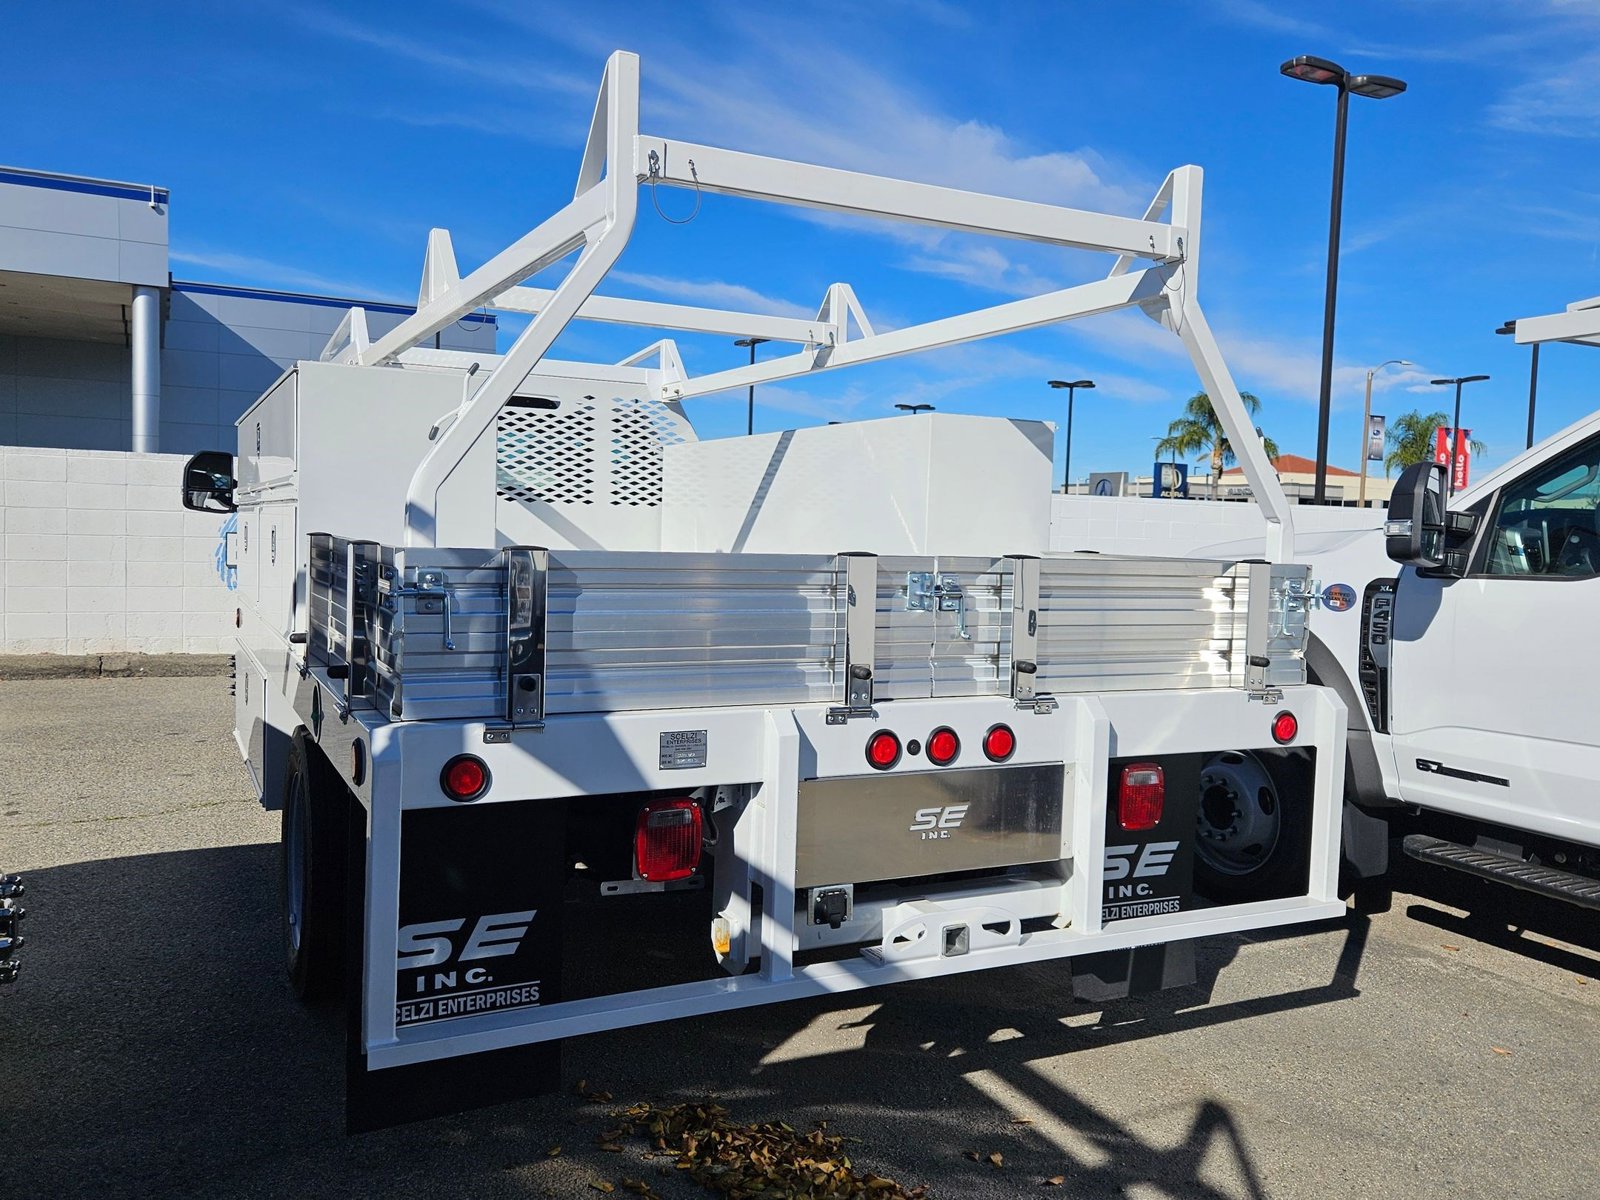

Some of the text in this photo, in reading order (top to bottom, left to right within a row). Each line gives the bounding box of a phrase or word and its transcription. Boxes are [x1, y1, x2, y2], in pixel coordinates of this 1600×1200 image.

[1454, 454, 1465, 487] hello
[670, 733, 697, 741] SCELZI
[909, 804, 969, 831] SE
[921, 830, 951, 840] INC.
[1103, 841, 1180, 881] SE
[1108, 883, 1153, 899] INC.
[1121, 900, 1180, 918] ENTERPRISES
[397, 909, 537, 970] SE
[416, 968, 493, 992] INC.
[438, 987, 540, 1016] ENTERPRISES
